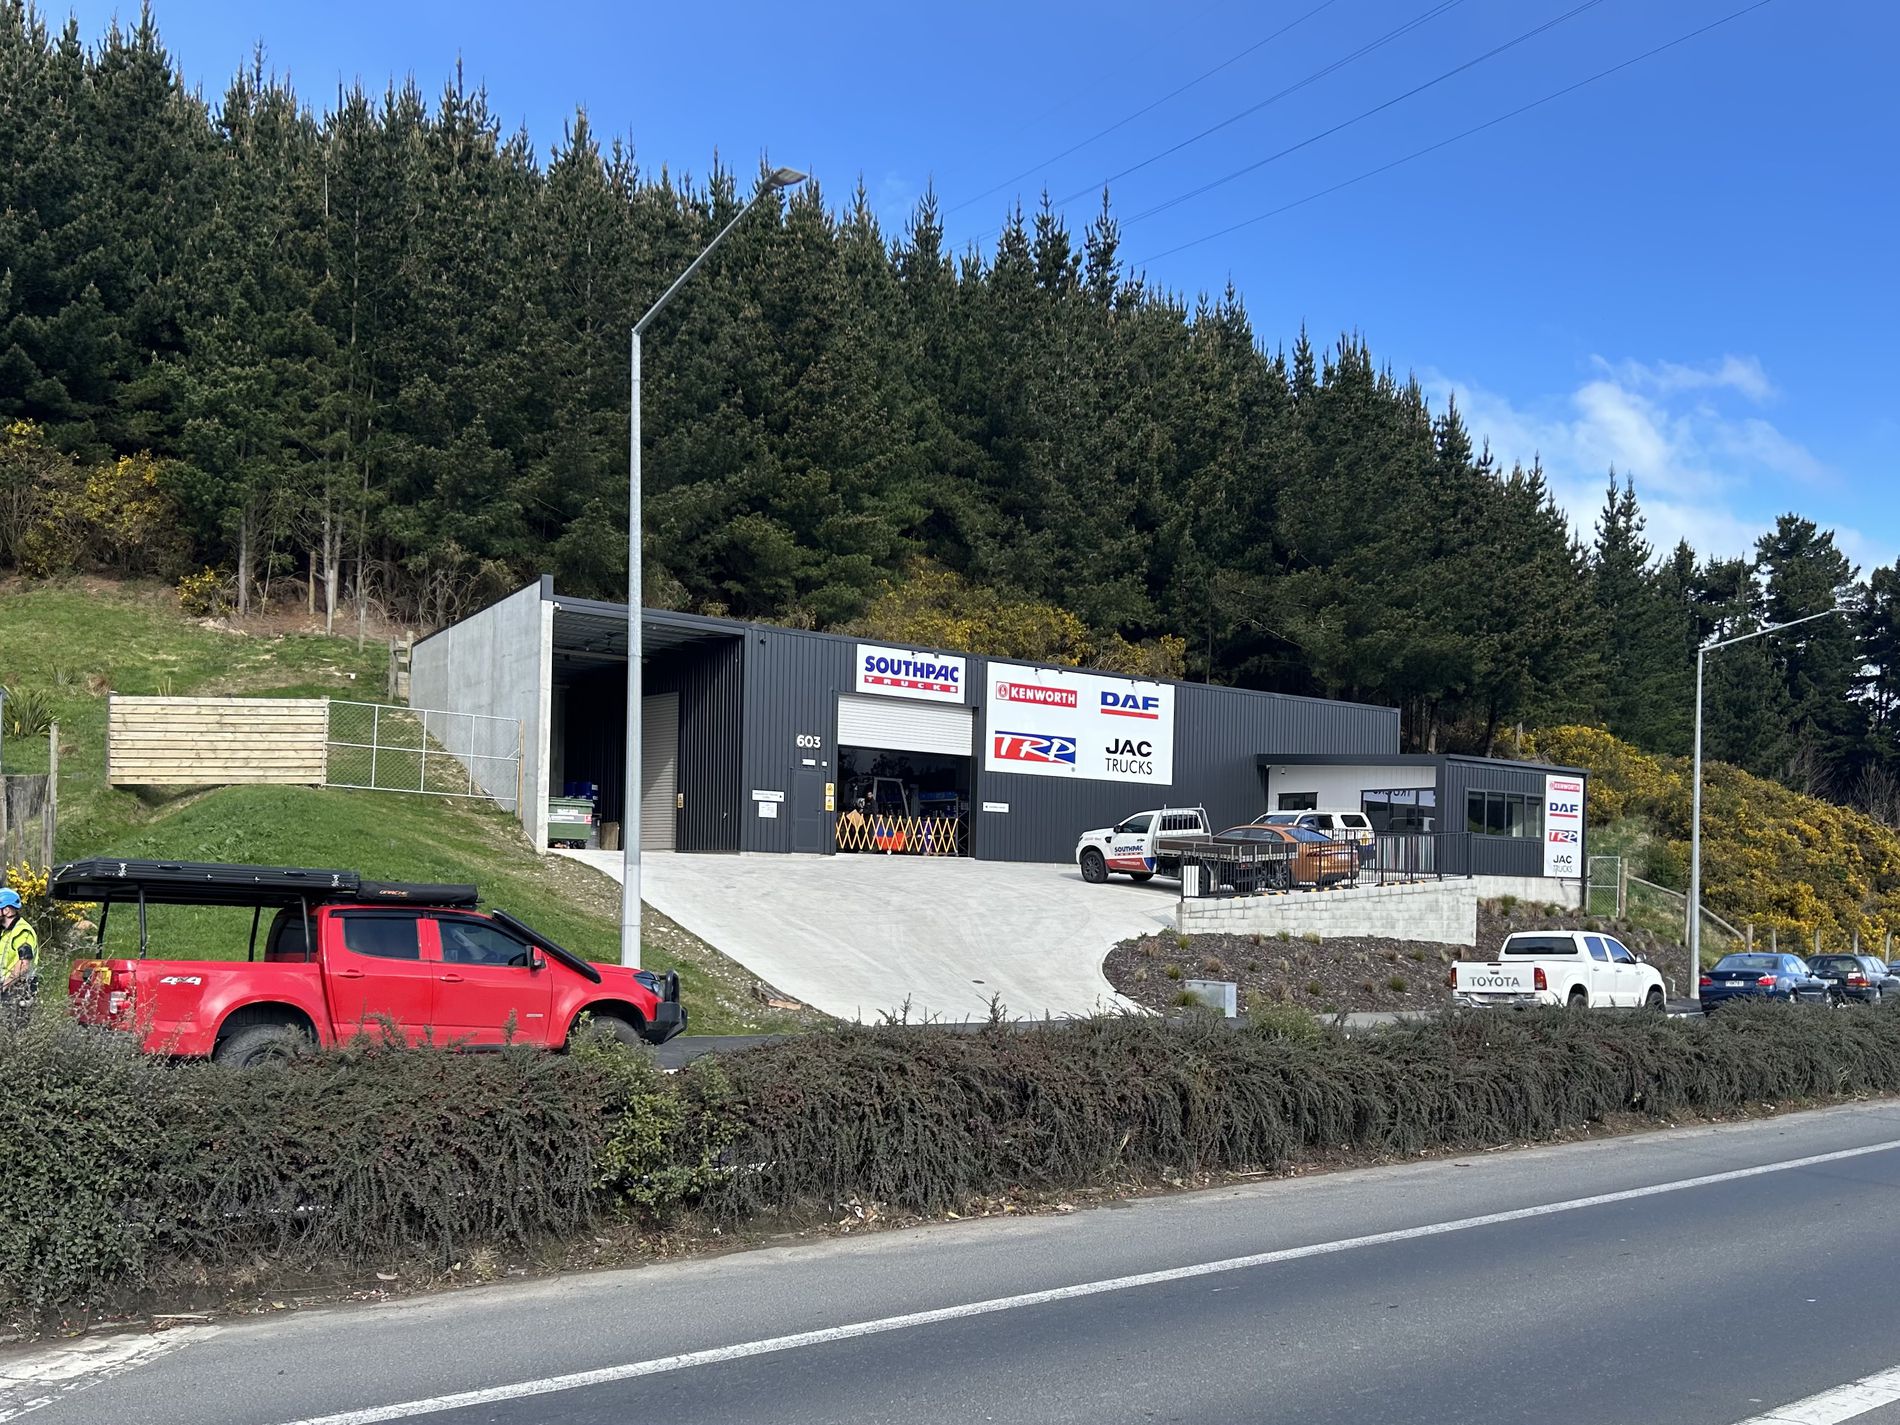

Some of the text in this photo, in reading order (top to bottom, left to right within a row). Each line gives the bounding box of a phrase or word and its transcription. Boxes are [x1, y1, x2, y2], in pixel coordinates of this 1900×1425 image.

[865, 655, 959, 683] SOUTHPAC
[865, 676, 957, 693] TRUCKS
[1011, 687, 1076, 705] KENWORTH
[1101, 691, 1159, 710] DAF
[796, 734, 821, 748] 603
[995, 731, 1076, 764] TRP
[1105, 738, 1152, 757] JAC
[1105, 757, 1152, 775] TRUCKS
[1549, 802, 1578, 813] DAF
[1549, 829, 1577, 843] TRP
[1114, 845, 1143, 853] SOUTHPAC
[1553, 855, 1572, 864] JAC
[1553, 864, 1572, 873] TRUCKS
[1469, 976, 1520, 987] TOYOTA
